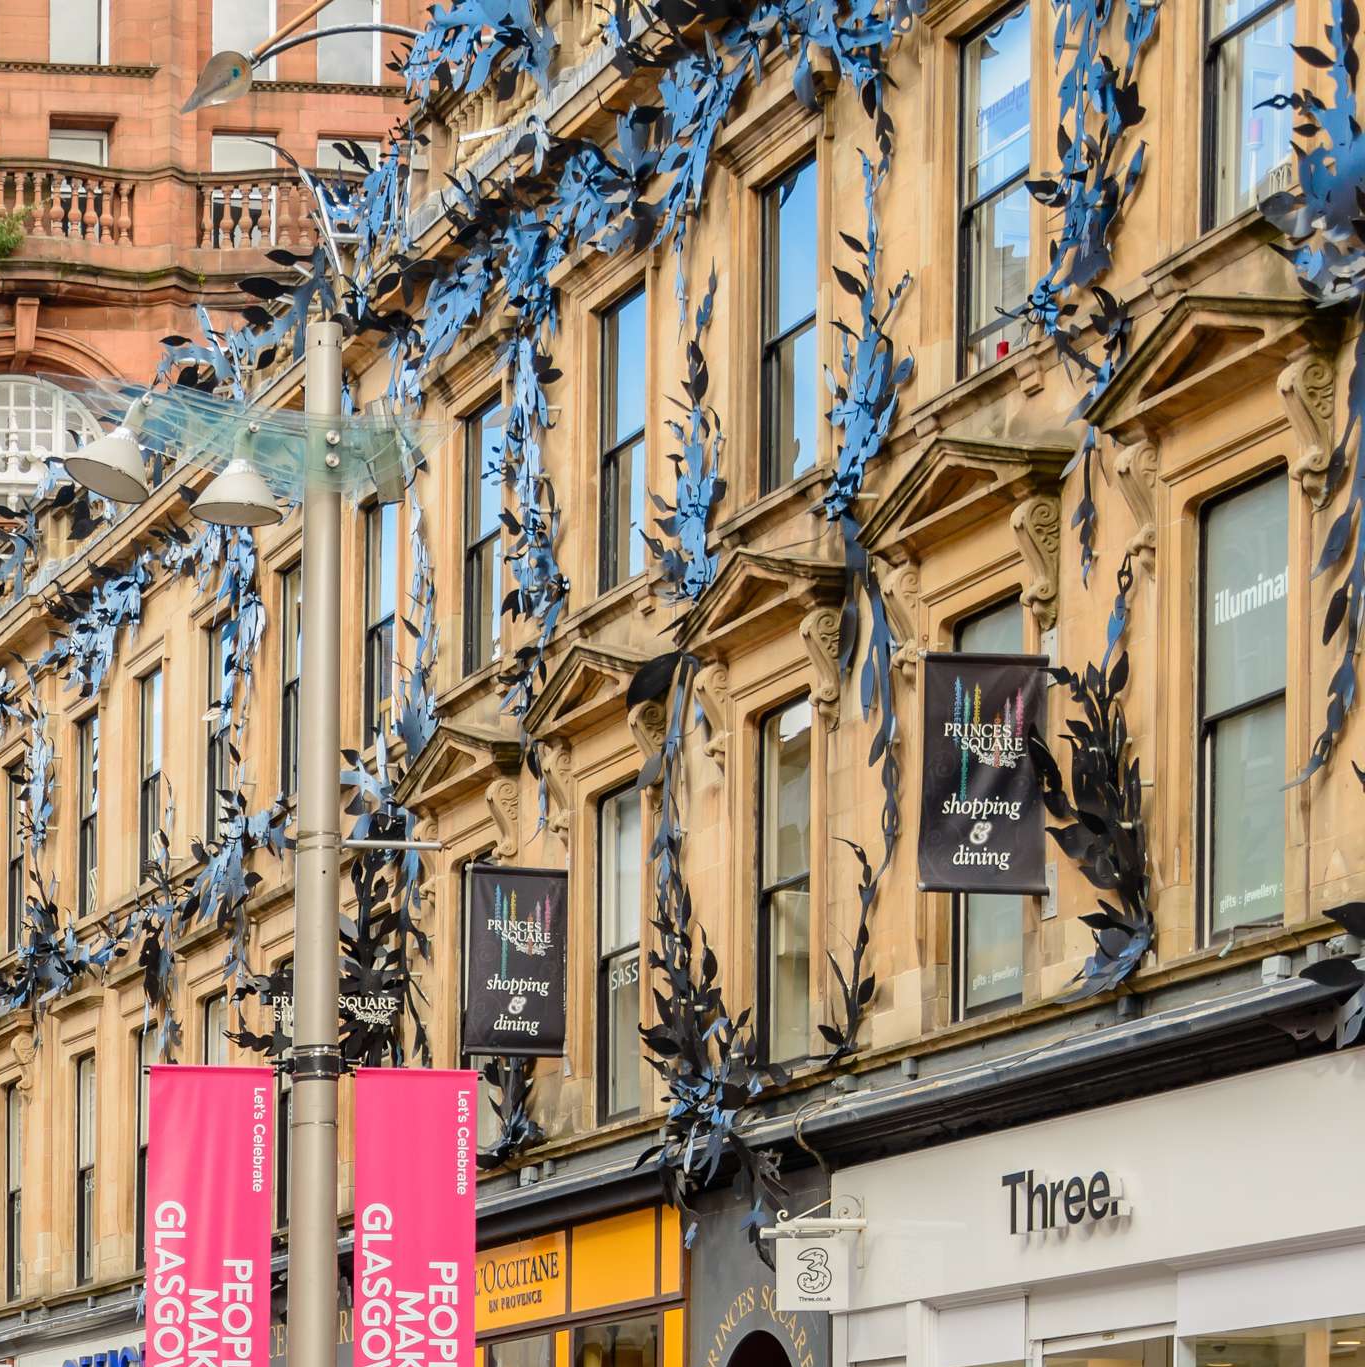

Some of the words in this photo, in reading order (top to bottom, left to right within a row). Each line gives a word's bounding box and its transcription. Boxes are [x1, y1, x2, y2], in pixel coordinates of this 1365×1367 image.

[943, 722, 1012, 737] PRINCES
[960, 737, 1023, 753] SQUARE
[941, 792, 1021, 821] shopping
[969, 821, 992, 845] &
[952, 844, 1011, 871] dining
[487, 919, 542, 933] PRINCES
[500, 930, 551, 946] SQUARE
[486, 973, 550, 997] shopping
[337, 996, 398, 1012] SQUARE
[508, 996, 527, 1014] &
[493, 1013, 540, 1037] dining
[253, 1087, 267, 1120] Let's
[457, 1090, 470, 1123] Let's
[252, 1123, 267, 1193] Celebrate
[456, 1127, 470, 1196] Celebrate
[501, 1290, 542, 1311] PROVENCE
